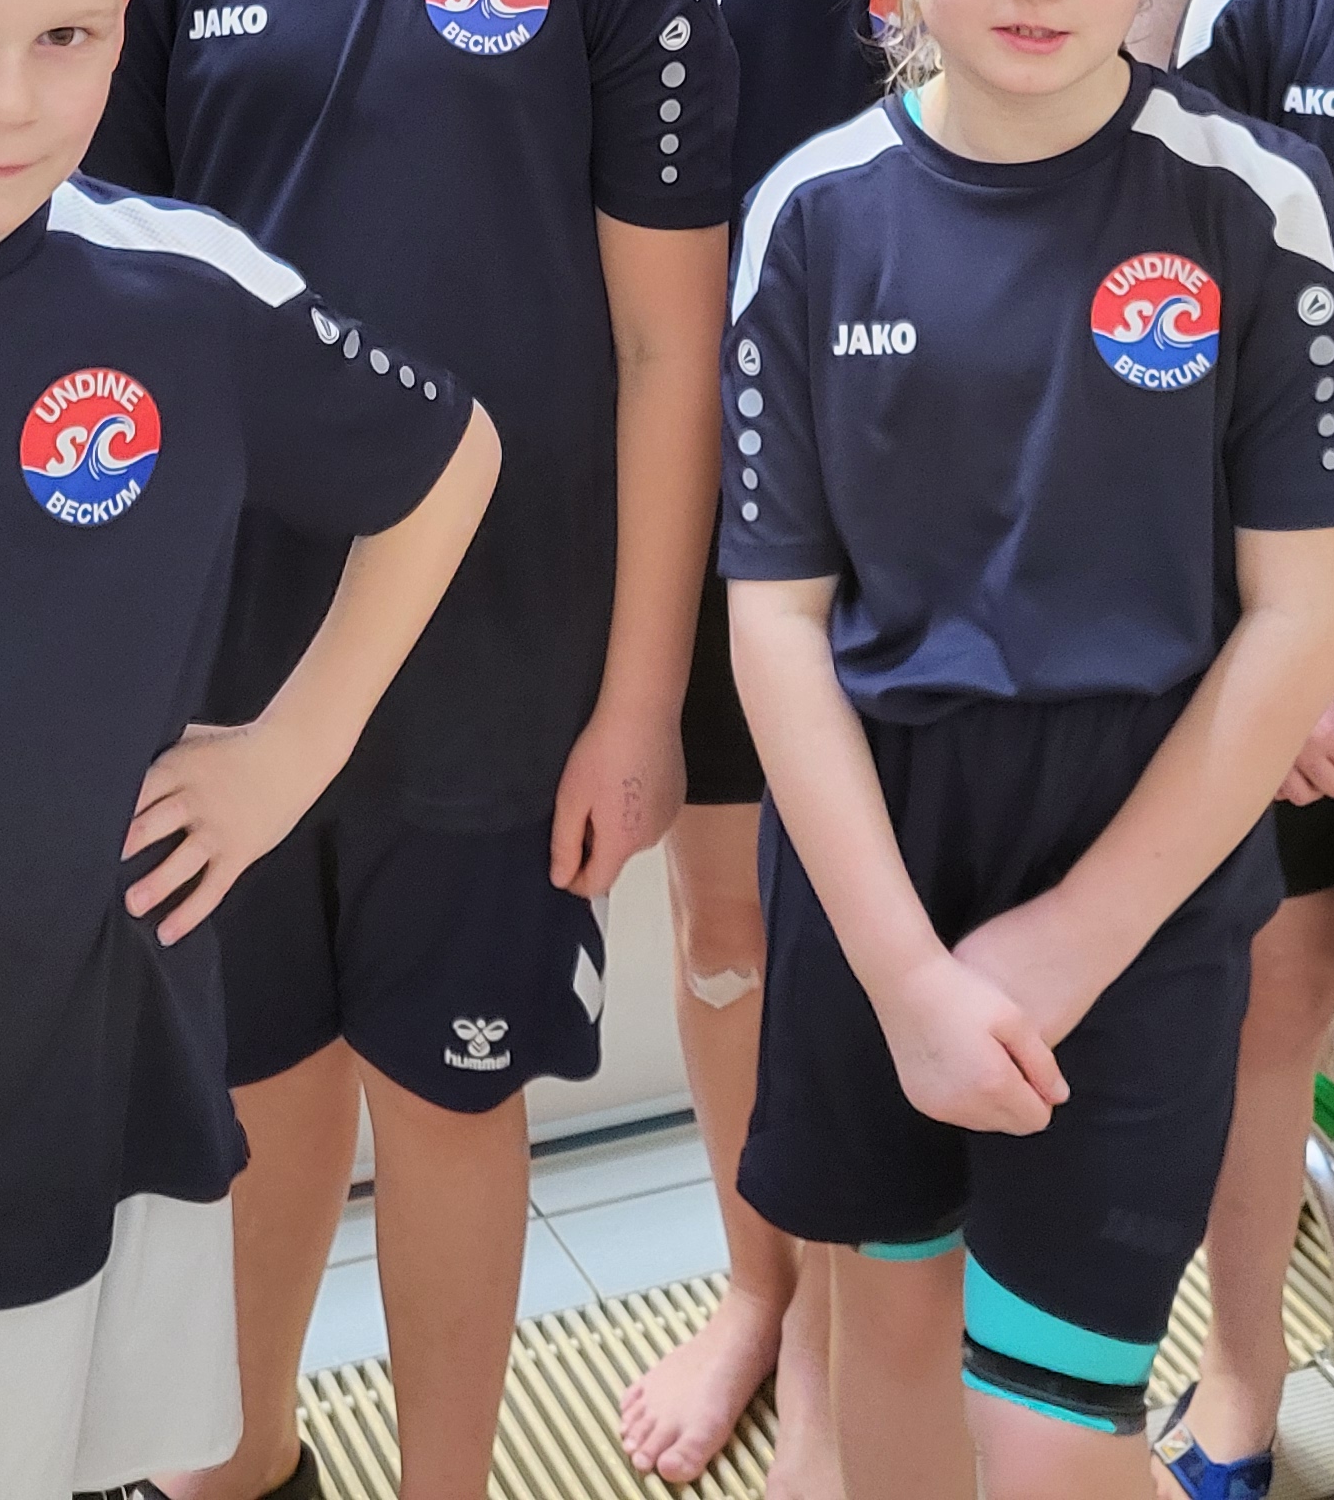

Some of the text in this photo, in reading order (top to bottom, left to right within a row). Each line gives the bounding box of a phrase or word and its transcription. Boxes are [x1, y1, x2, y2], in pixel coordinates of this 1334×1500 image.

[189, 5, 267, 39] JAKO
[442, 21, 531, 54] BECKUM
[1106, 257, 1209, 296] UNDINE
[833, 323, 917, 356] JAKO
[1114, 353, 1211, 388] BECKUM
[35, 373, 144, 425] UNDINE
[46, 479, 142, 523] BECKUM
